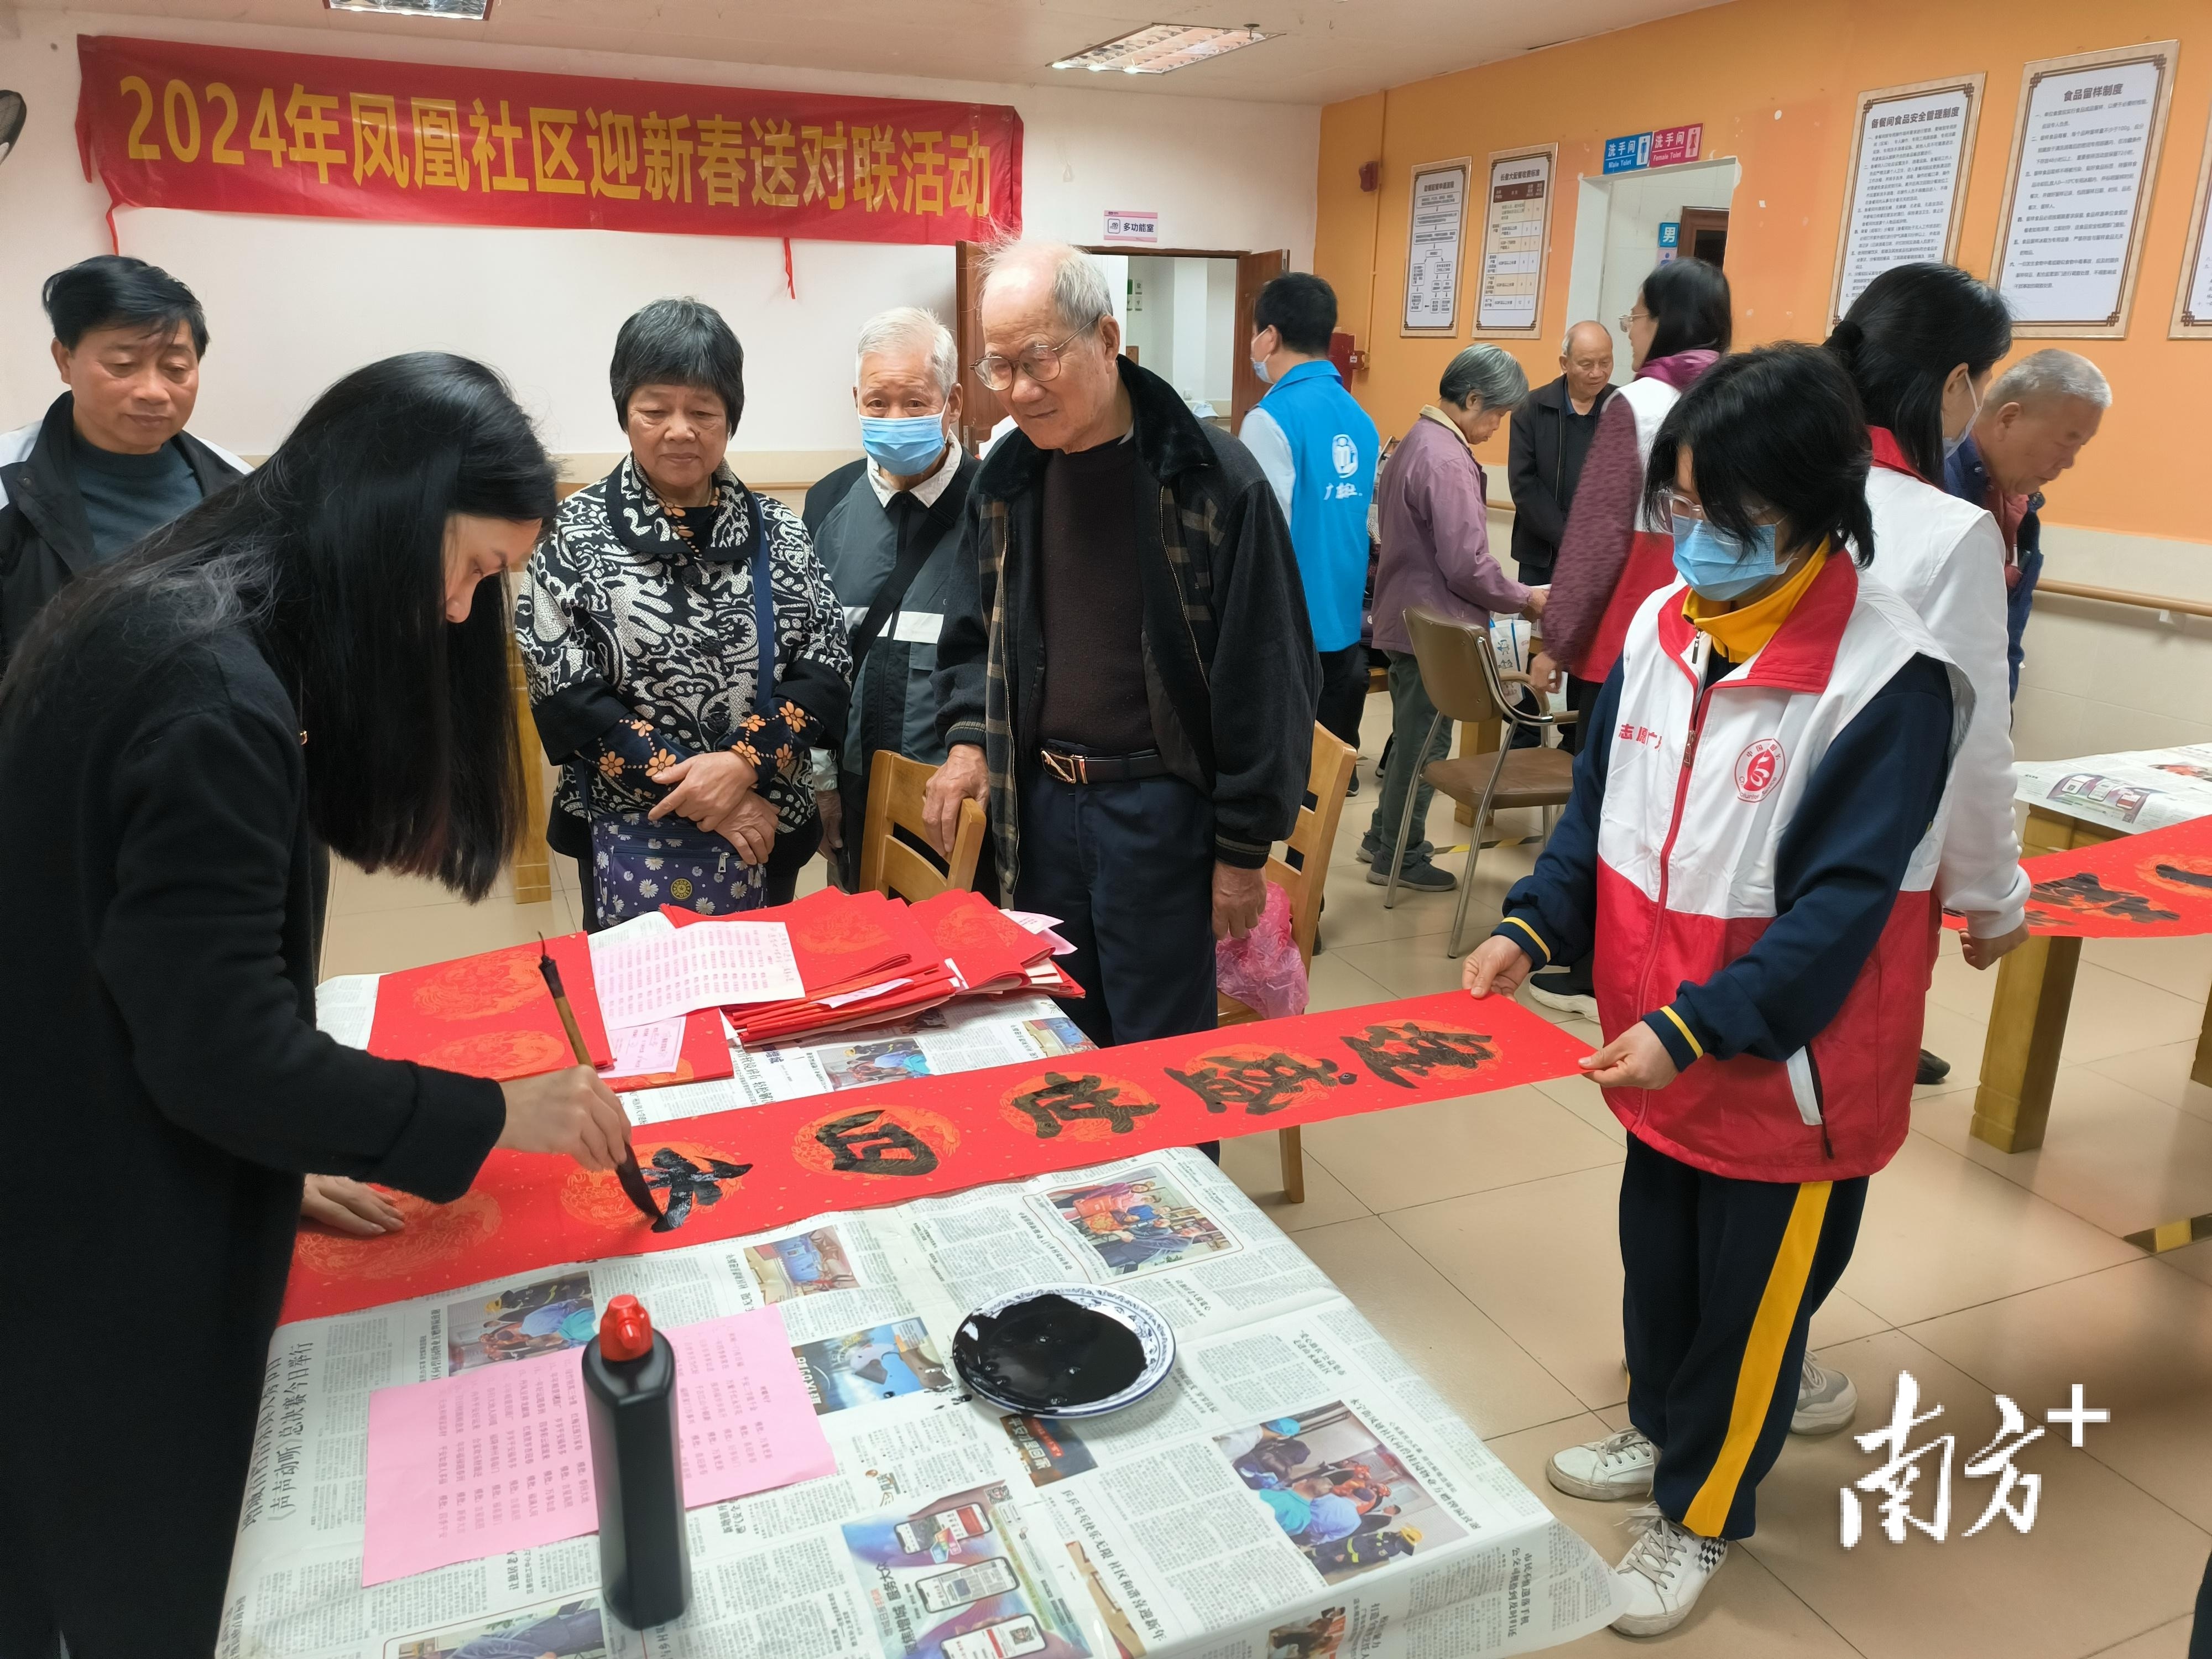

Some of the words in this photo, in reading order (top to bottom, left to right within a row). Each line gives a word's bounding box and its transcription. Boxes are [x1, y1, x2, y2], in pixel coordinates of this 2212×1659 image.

[2064, 83, 2124, 102] 食品留样制度
[1871, 106, 1960, 129] 备餐间食品安全管理制度
[119, 76, 990, 217] 2024年凤凰社区迎新春送对联活动
[1608, 140, 1636, 157] 洗手间
[1655, 131, 1685, 149] 洗手间
[1670, 150, 1682, 159] Toilet
[1123, 222, 1154, 233] 多功能室
[1662, 227, 1676, 243] 男
[268, 1340, 314, 1521] 《声声动听》总决赛今日举行
[1060, 1490, 1111, 1561] 乒乒乓乓快乐无限
[1108, 1560, 1167, 1642] 社区和谐喜迎新年
[877, 1561, 902, 1603] 服务大众
[896, 1604, 918, 1656] 聚焦增城
